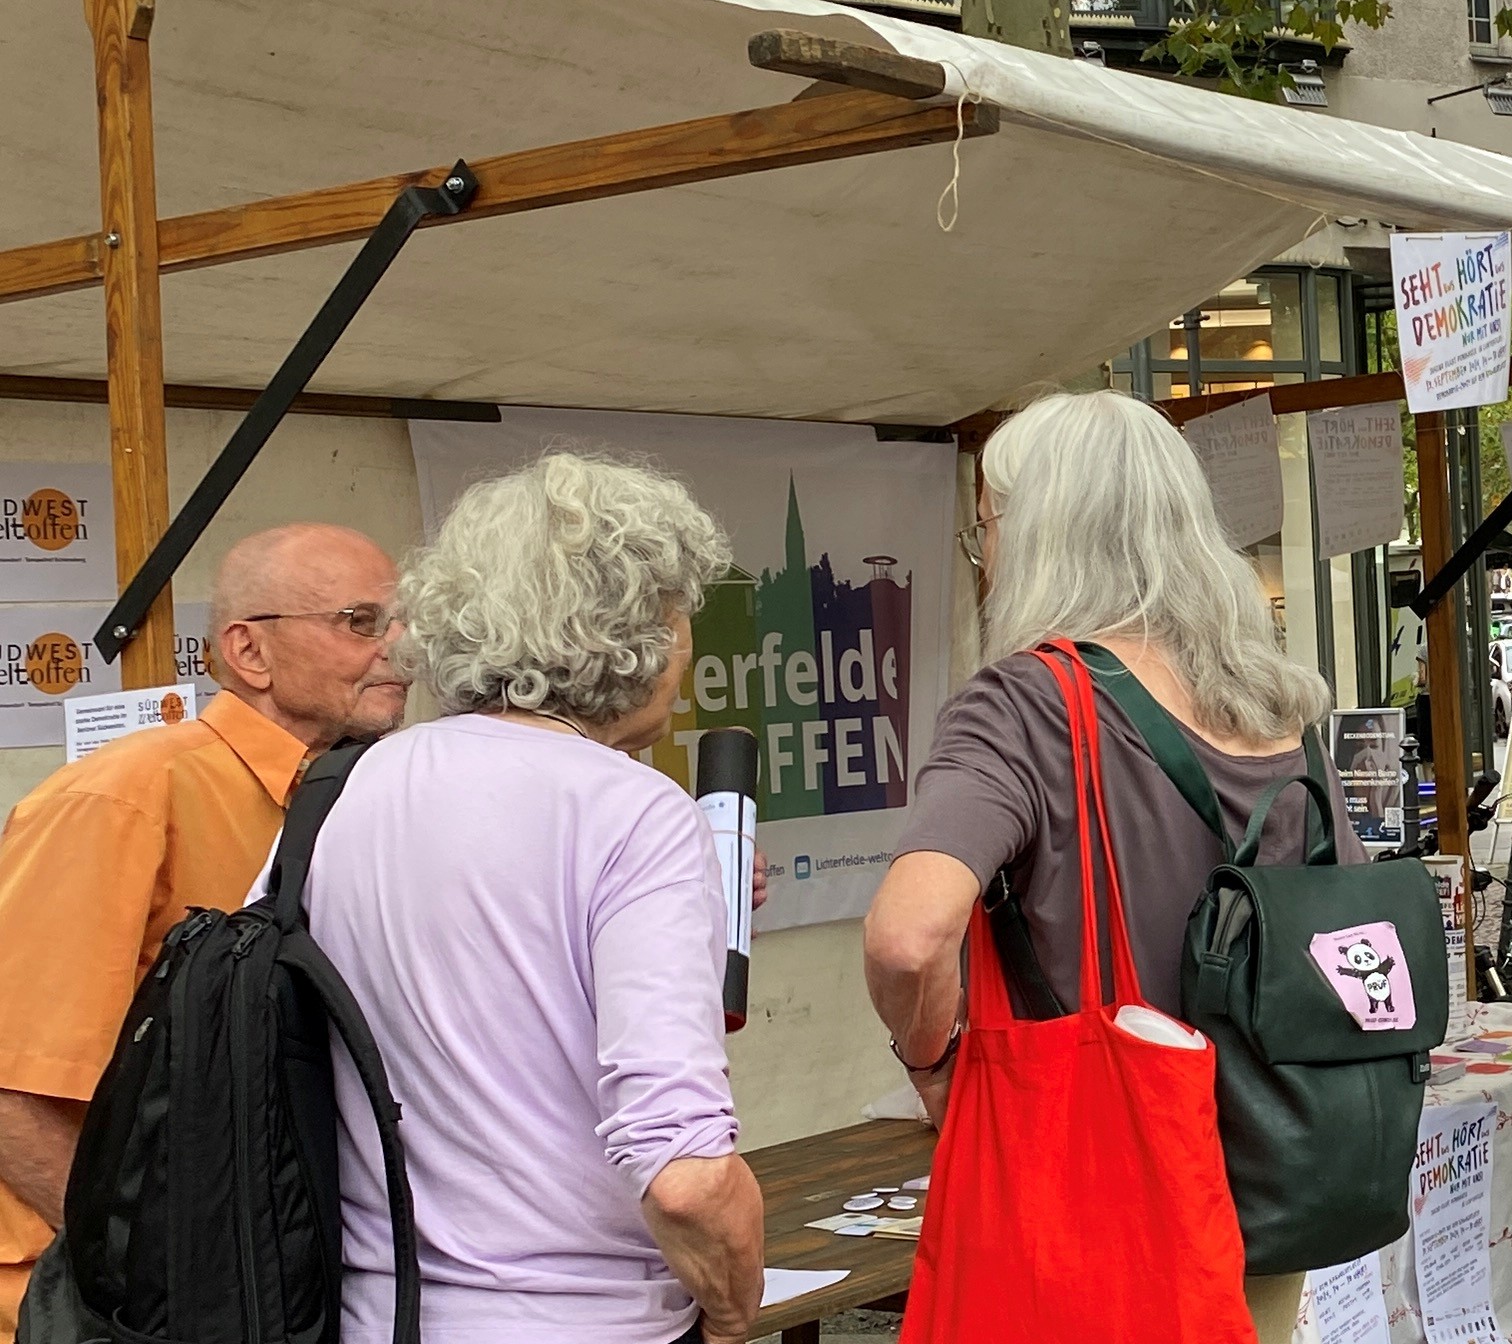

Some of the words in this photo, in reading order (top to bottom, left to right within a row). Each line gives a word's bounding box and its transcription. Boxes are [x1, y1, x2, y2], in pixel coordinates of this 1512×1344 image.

[1400, 261, 1443, 309] SEHT
[1456, 244, 1494, 290] HÖRT
[3, 498, 89, 517] DWEST
[4, 642, 93, 662] DWEST
[676, 628, 898, 714] erfelde
[1452, 1117, 1485, 1152] HÖRT
